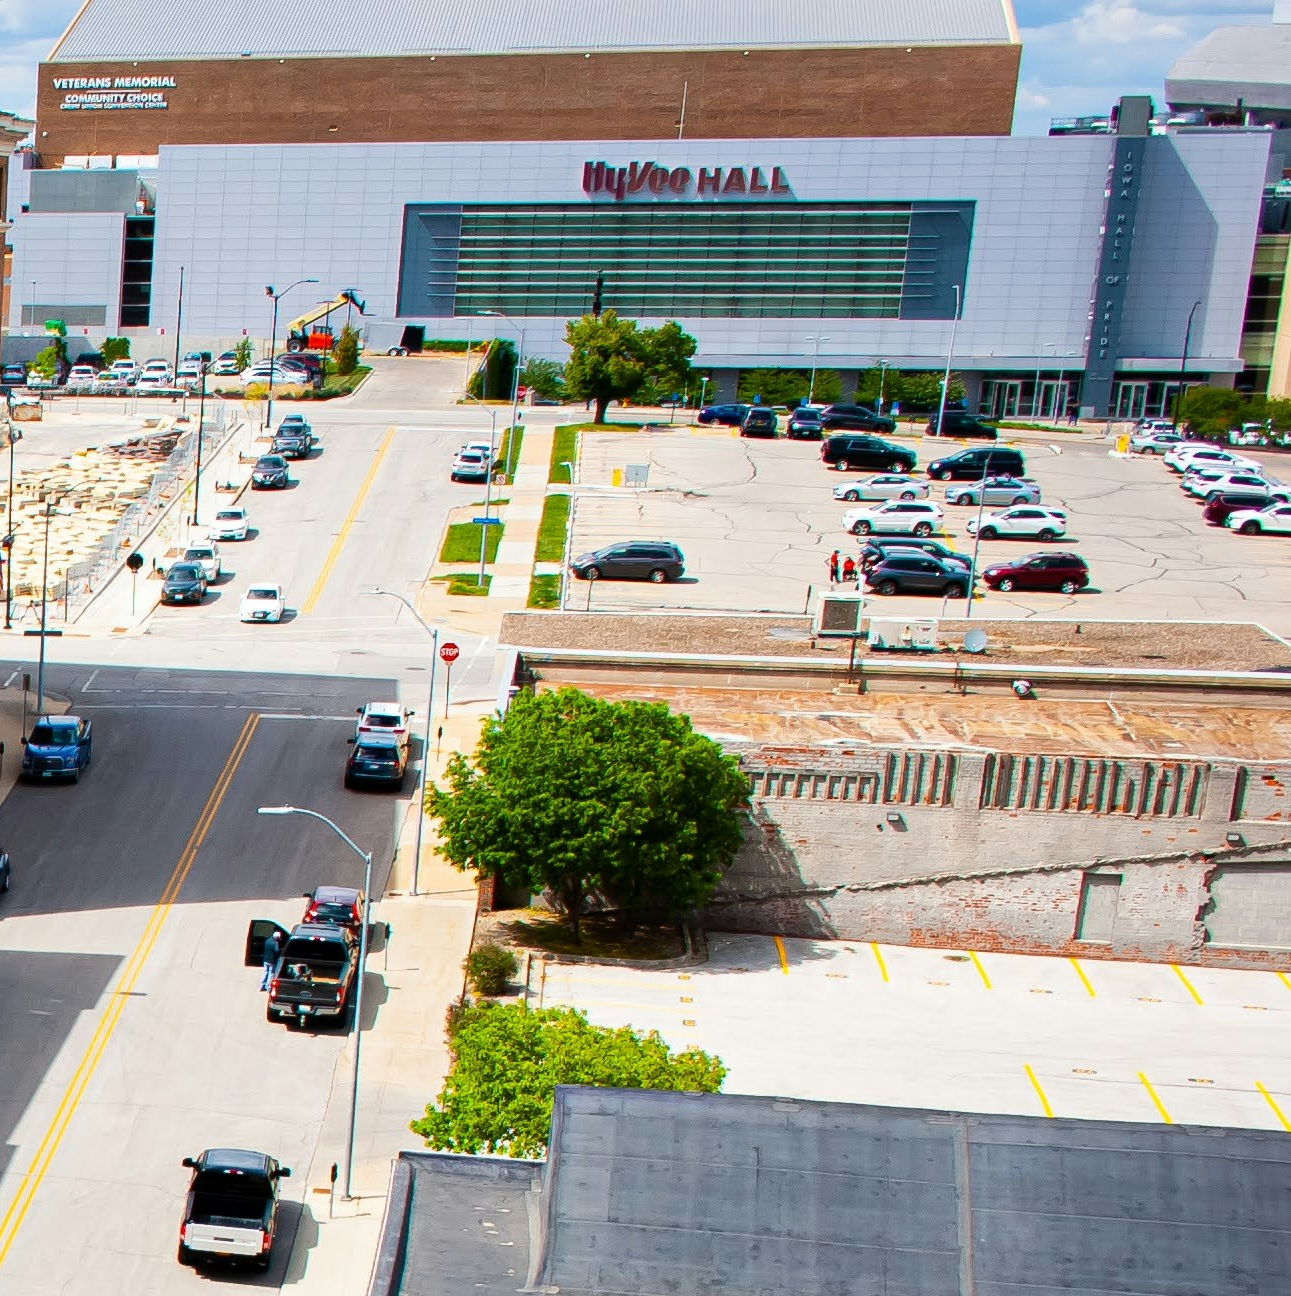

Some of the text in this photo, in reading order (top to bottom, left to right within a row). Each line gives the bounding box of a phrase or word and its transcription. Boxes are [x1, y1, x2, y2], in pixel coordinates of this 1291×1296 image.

[53, 76, 177, 89] VETERANS MEMORIAL
[65, 92, 164, 103] COMMUNITY CHOICE
[697, 166, 790, 194] HALL
[1120, 151, 1133, 197] IOWA
[1113, 214, 1126, 260] HALL
[1105, 275, 1120, 285] OF
[1099, 300, 1113, 358] PRIDE
[440, 647, 459, 657] STOP
